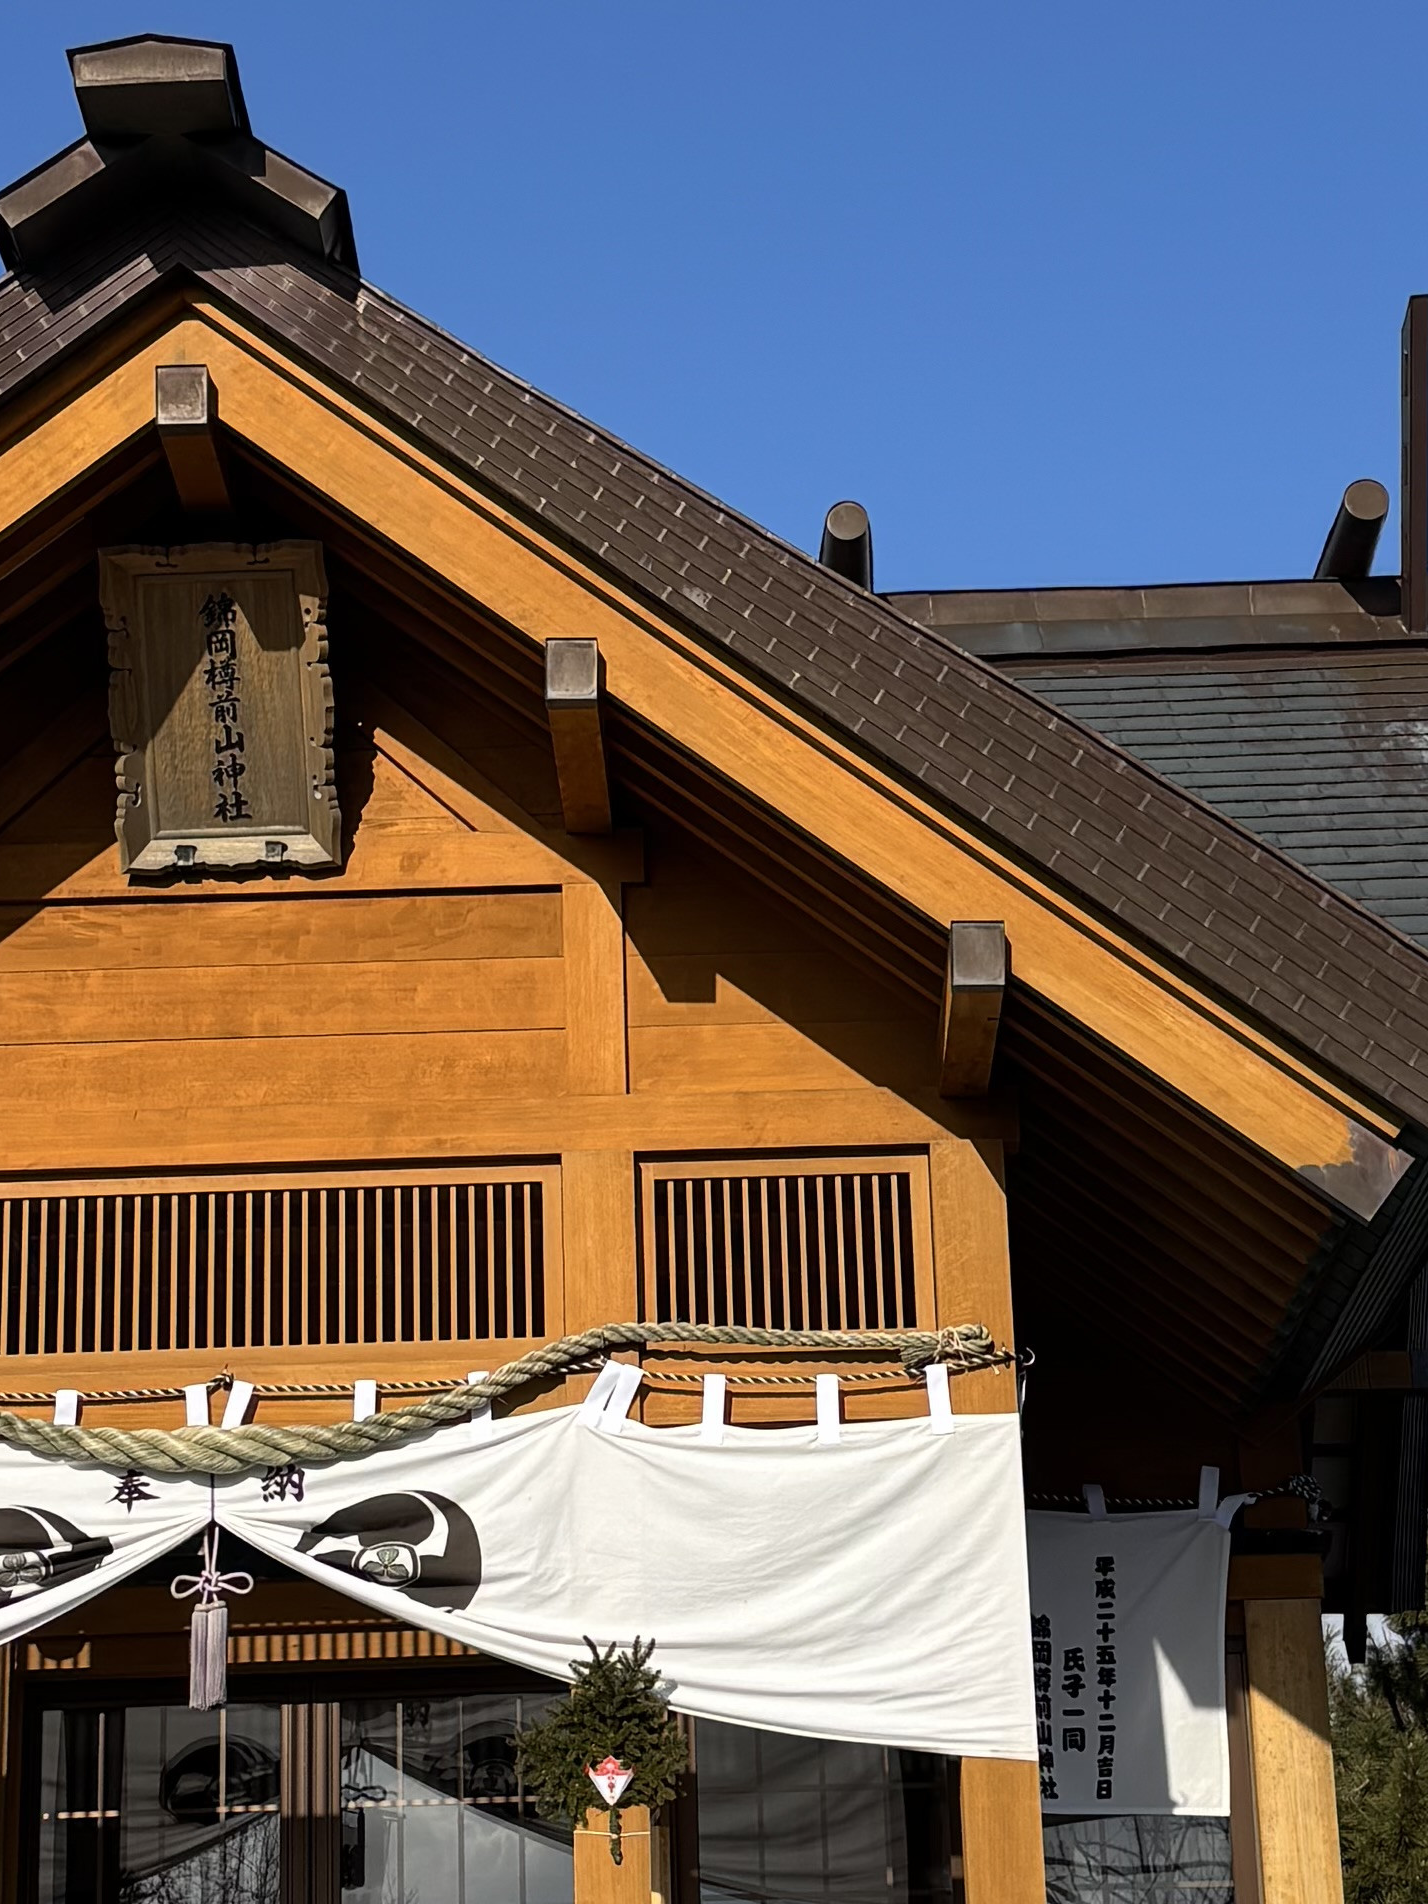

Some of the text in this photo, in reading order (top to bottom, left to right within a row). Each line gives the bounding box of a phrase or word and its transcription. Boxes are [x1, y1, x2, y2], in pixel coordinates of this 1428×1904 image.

[199, 592, 253, 824] 錦岡樽前山神社
[105, 1464, 306, 1513] 奉 納
[1062, 1647, 1086, 1753] 氏子一同
[1094, 1555, 1117, 1800] 平成二十五年十二月吉日
